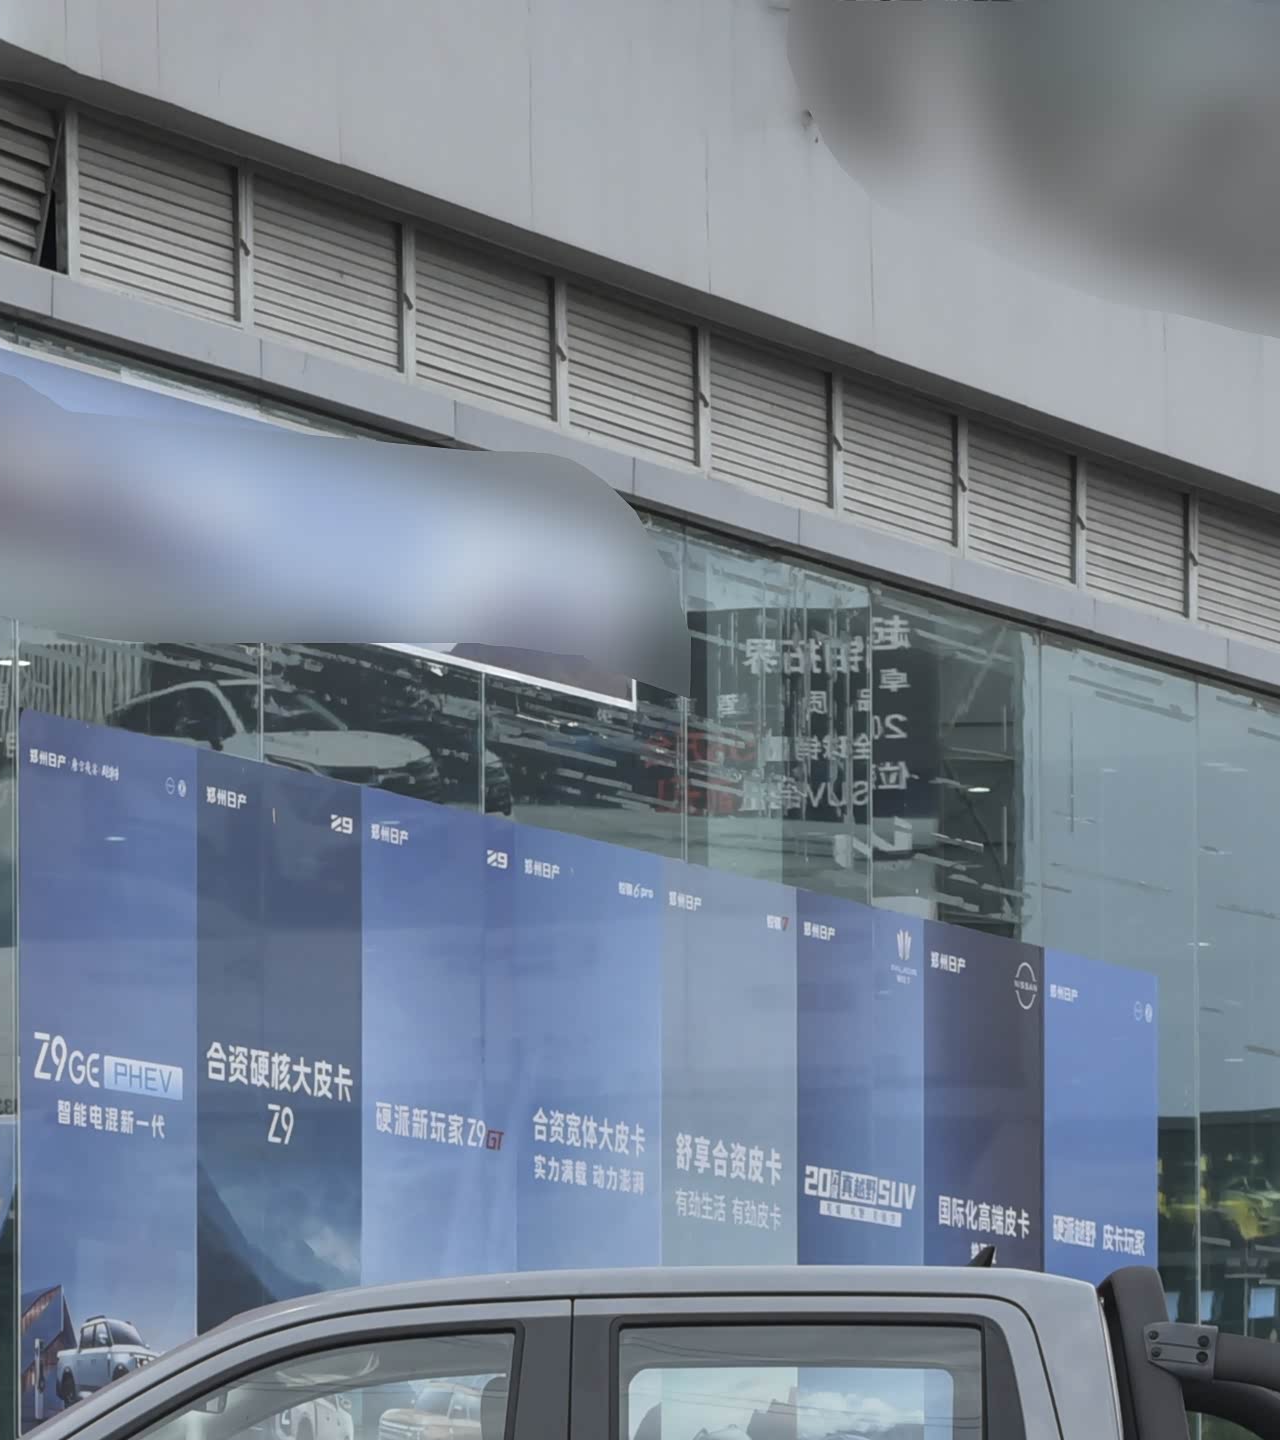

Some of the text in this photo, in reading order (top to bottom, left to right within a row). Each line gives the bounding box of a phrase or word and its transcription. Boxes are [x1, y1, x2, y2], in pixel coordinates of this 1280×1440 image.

[30, 748, 66, 769] 郑州日产
[206, 786, 247, 810] 郑州日产
[371, 823, 409, 846] 郑州日产
[524, 857, 560, 880] 郑州日产
[669, 890, 702, 911] 郑州日产
[804, 921, 835, 942] 郑州日产
[930, 951, 966, 975] 郑州日产
[1049, 982, 1078, 1003] 郑州日产
[113, 1061, 174, 1095] PHEV
[206, 1040, 354, 1103] 合资硬核大皮卡
[57, 1099, 166, 1139] 智能电混新一代
[267, 1103, 295, 1145] Z9
[375, 1101, 464, 1147] 硬派新玩家
[532, 1106, 646, 1158] 合资宽体大皮卡
[676, 1132, 782, 1187] 舒享合资皮卡
[938, 1195, 1031, 1240] 国际化高端皮卡
[1052, 1214, 1146, 1257] 硬派越野 皮卡玩家
